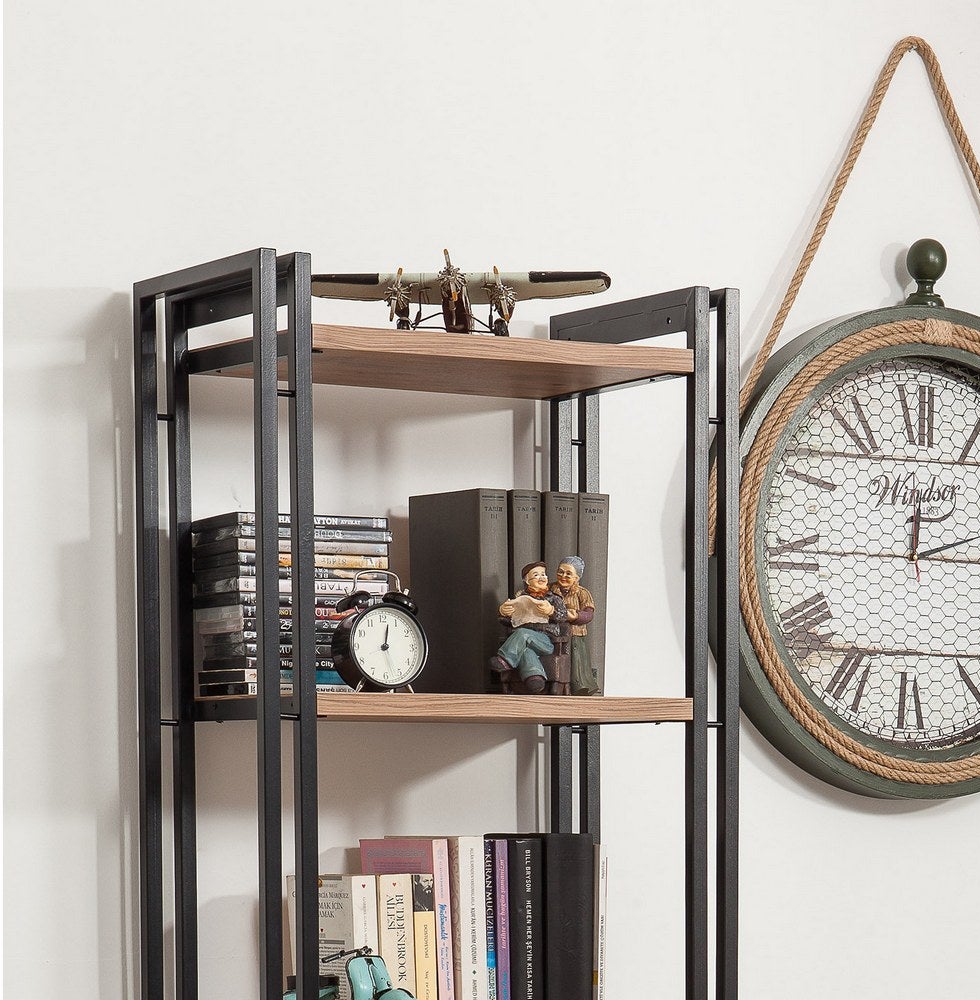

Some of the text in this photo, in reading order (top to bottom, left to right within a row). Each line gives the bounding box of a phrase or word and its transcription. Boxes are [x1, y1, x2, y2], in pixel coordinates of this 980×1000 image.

[868, 471, 961, 511] Windsor
[379, 614, 387, 623] 12
[367, 619, 373, 627] 11
[358, 629, 366, 637] 10
[404, 630, 409, 638] 2
[360, 657, 365, 665] 8
[370, 667, 375, 676] 7
[383, 672, 389, 680] 6
[395, 894, 407, 983] BUDDENBROOK
